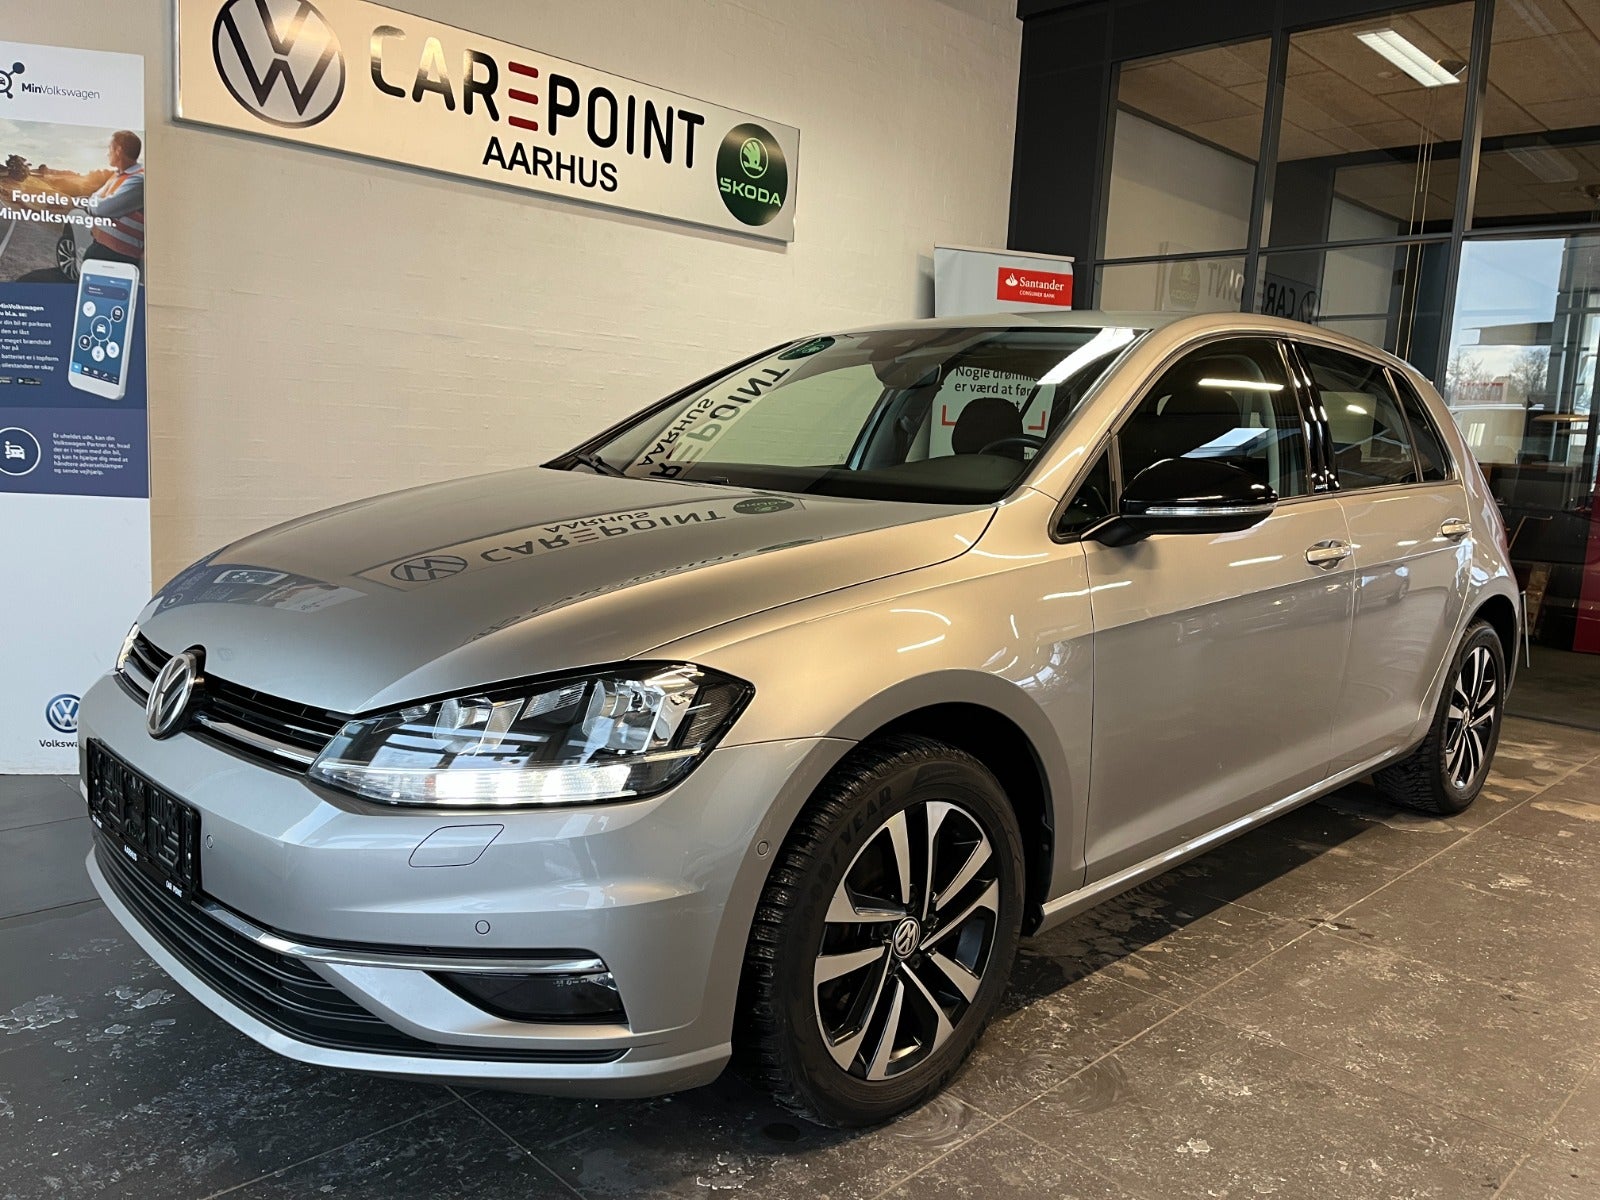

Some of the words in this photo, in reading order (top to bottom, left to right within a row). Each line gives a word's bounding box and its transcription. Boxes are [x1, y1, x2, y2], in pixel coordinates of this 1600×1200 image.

[21, 83, 100, 100] MinVolkswagen
[370, 25, 705, 169] CAREPOINT
[482, 136, 618, 192] AARHUS
[12, 189, 68, 206] Fordele
[71, 195, 98, 208] ved
[1019, 276, 1065, 291] Santander
[1019, 290, 1043, 298] CONSUMER
[955, 366, 990, 381] Nogle
[955, 384, 967, 392] er
[970, 383, 998, 394] værd
[1001, 385, 1013, 395] at
